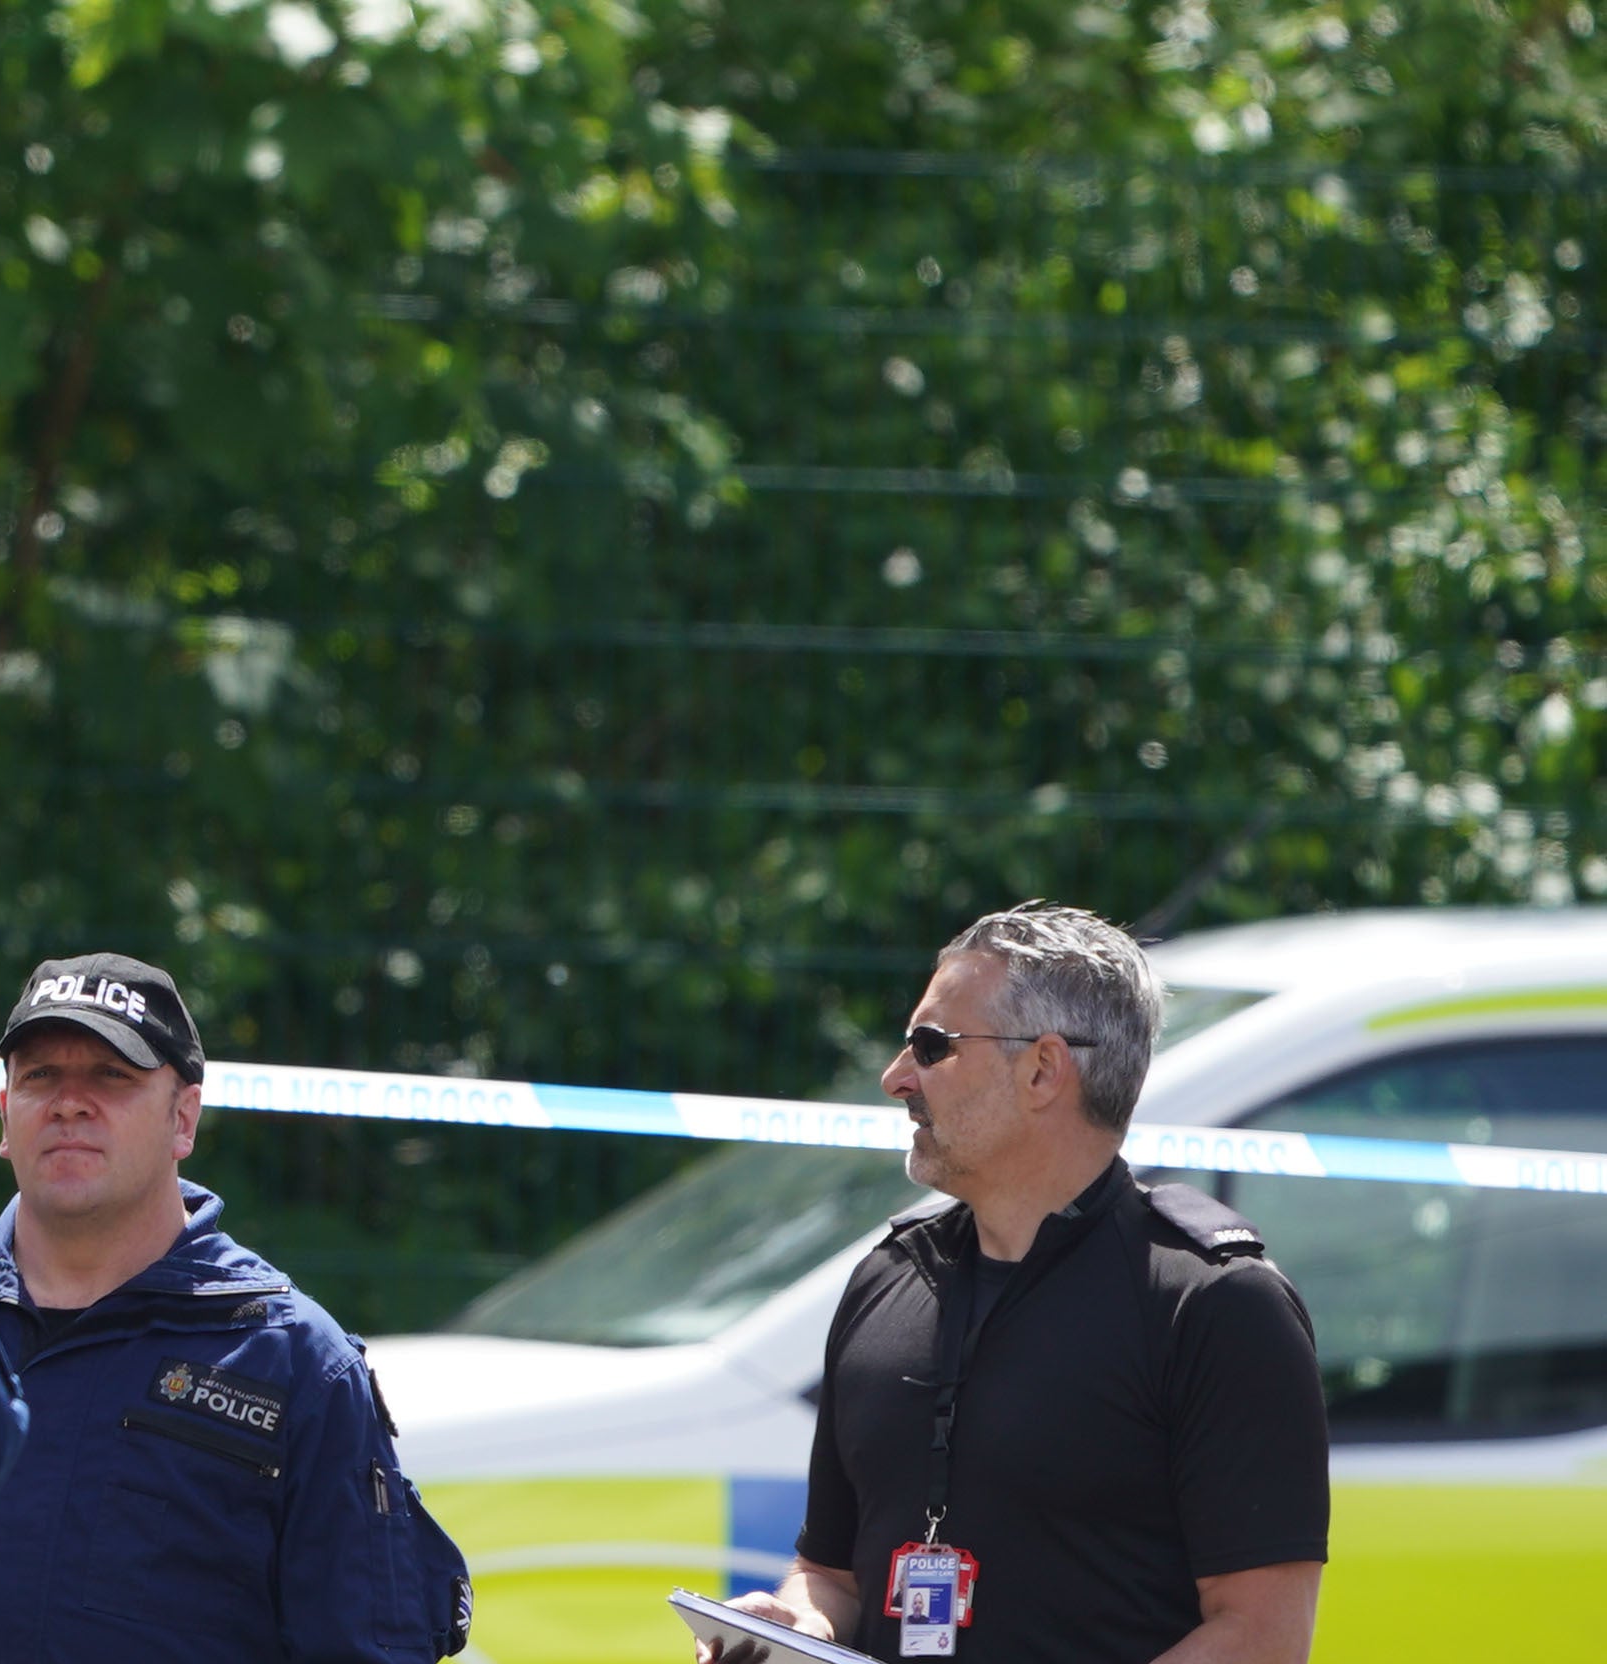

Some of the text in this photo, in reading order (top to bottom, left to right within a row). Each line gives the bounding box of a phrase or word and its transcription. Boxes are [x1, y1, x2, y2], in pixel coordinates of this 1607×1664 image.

[30, 975, 146, 1024] POLICE
[223, 1073, 513, 1125] DO NOT CROSS
[1159, 1134, 1286, 1174] CROSS
[192, 1386, 279, 1431] POLICE
[199, 1378, 233, 1395] GREATER
[233, 1389, 281, 1411] MANCHESTER
[909, 1558, 956, 1570] POLICE
